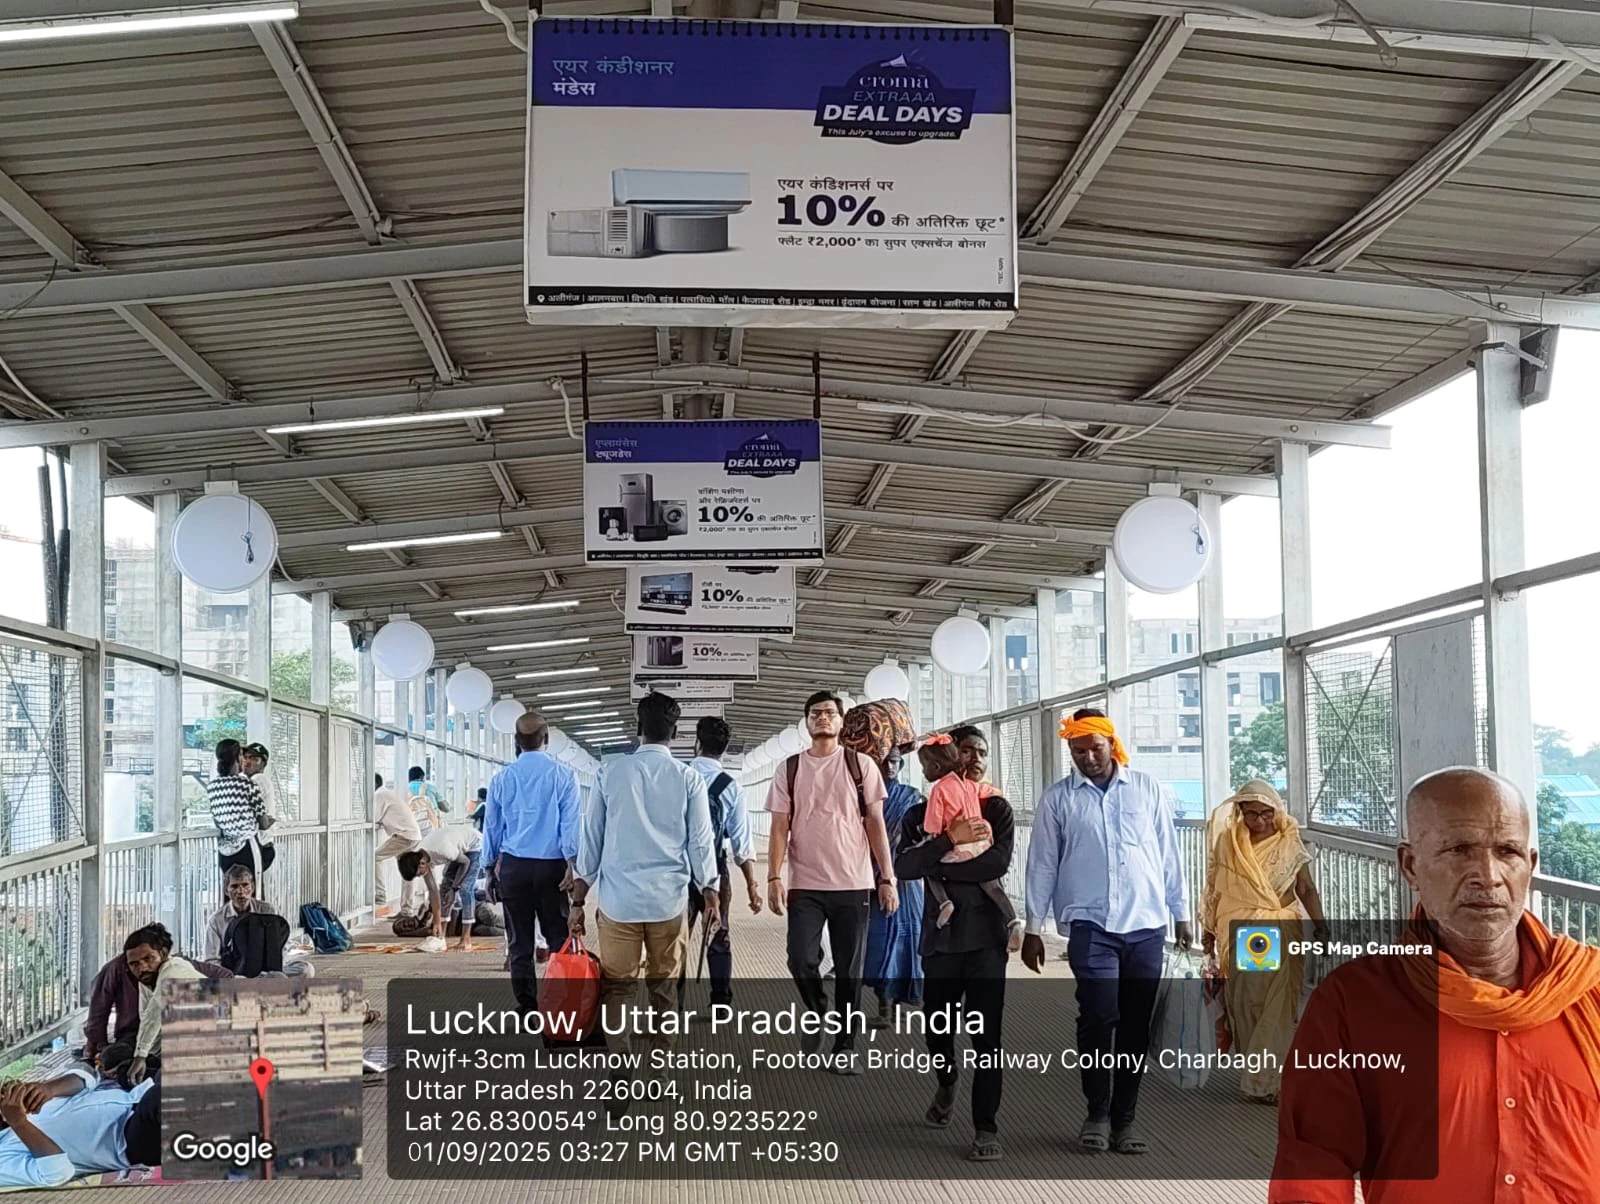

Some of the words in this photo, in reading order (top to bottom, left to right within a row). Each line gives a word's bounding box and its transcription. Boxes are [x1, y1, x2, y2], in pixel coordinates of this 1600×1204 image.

[553, 59, 587, 75] एयर
[597, 56, 675, 76] कंडीशनर
[553, 77, 596, 96] मंडेस
[853, 91, 936, 103] EXTRAAA
[823, 105, 890, 122] DEAL
[895, 106, 963, 123] DAYS
[828, 128, 846, 136] This
[848, 129, 874, 138] July's
[778, 178, 804, 190] एयर
[810, 176, 871, 191] कंडिशनर्स
[877, 180, 895, 192] पर
[777, 194, 886, 228] 10%
[891, 214, 910, 227] की
[915, 214, 969, 229] अतिरिक्त
[778, 235, 803, 247] फ्लैट
[865, 237, 880, 248] का
[884, 239, 907, 251] सुपर
[958, 238, 986, 249] बोनस
[728, 458, 760, 468] DEAL
[763, 458, 797, 468] DAYS
[698, 506, 754, 523] 10%
[701, 589, 744, 603] 10%
[692, 647, 723, 657] 10%
